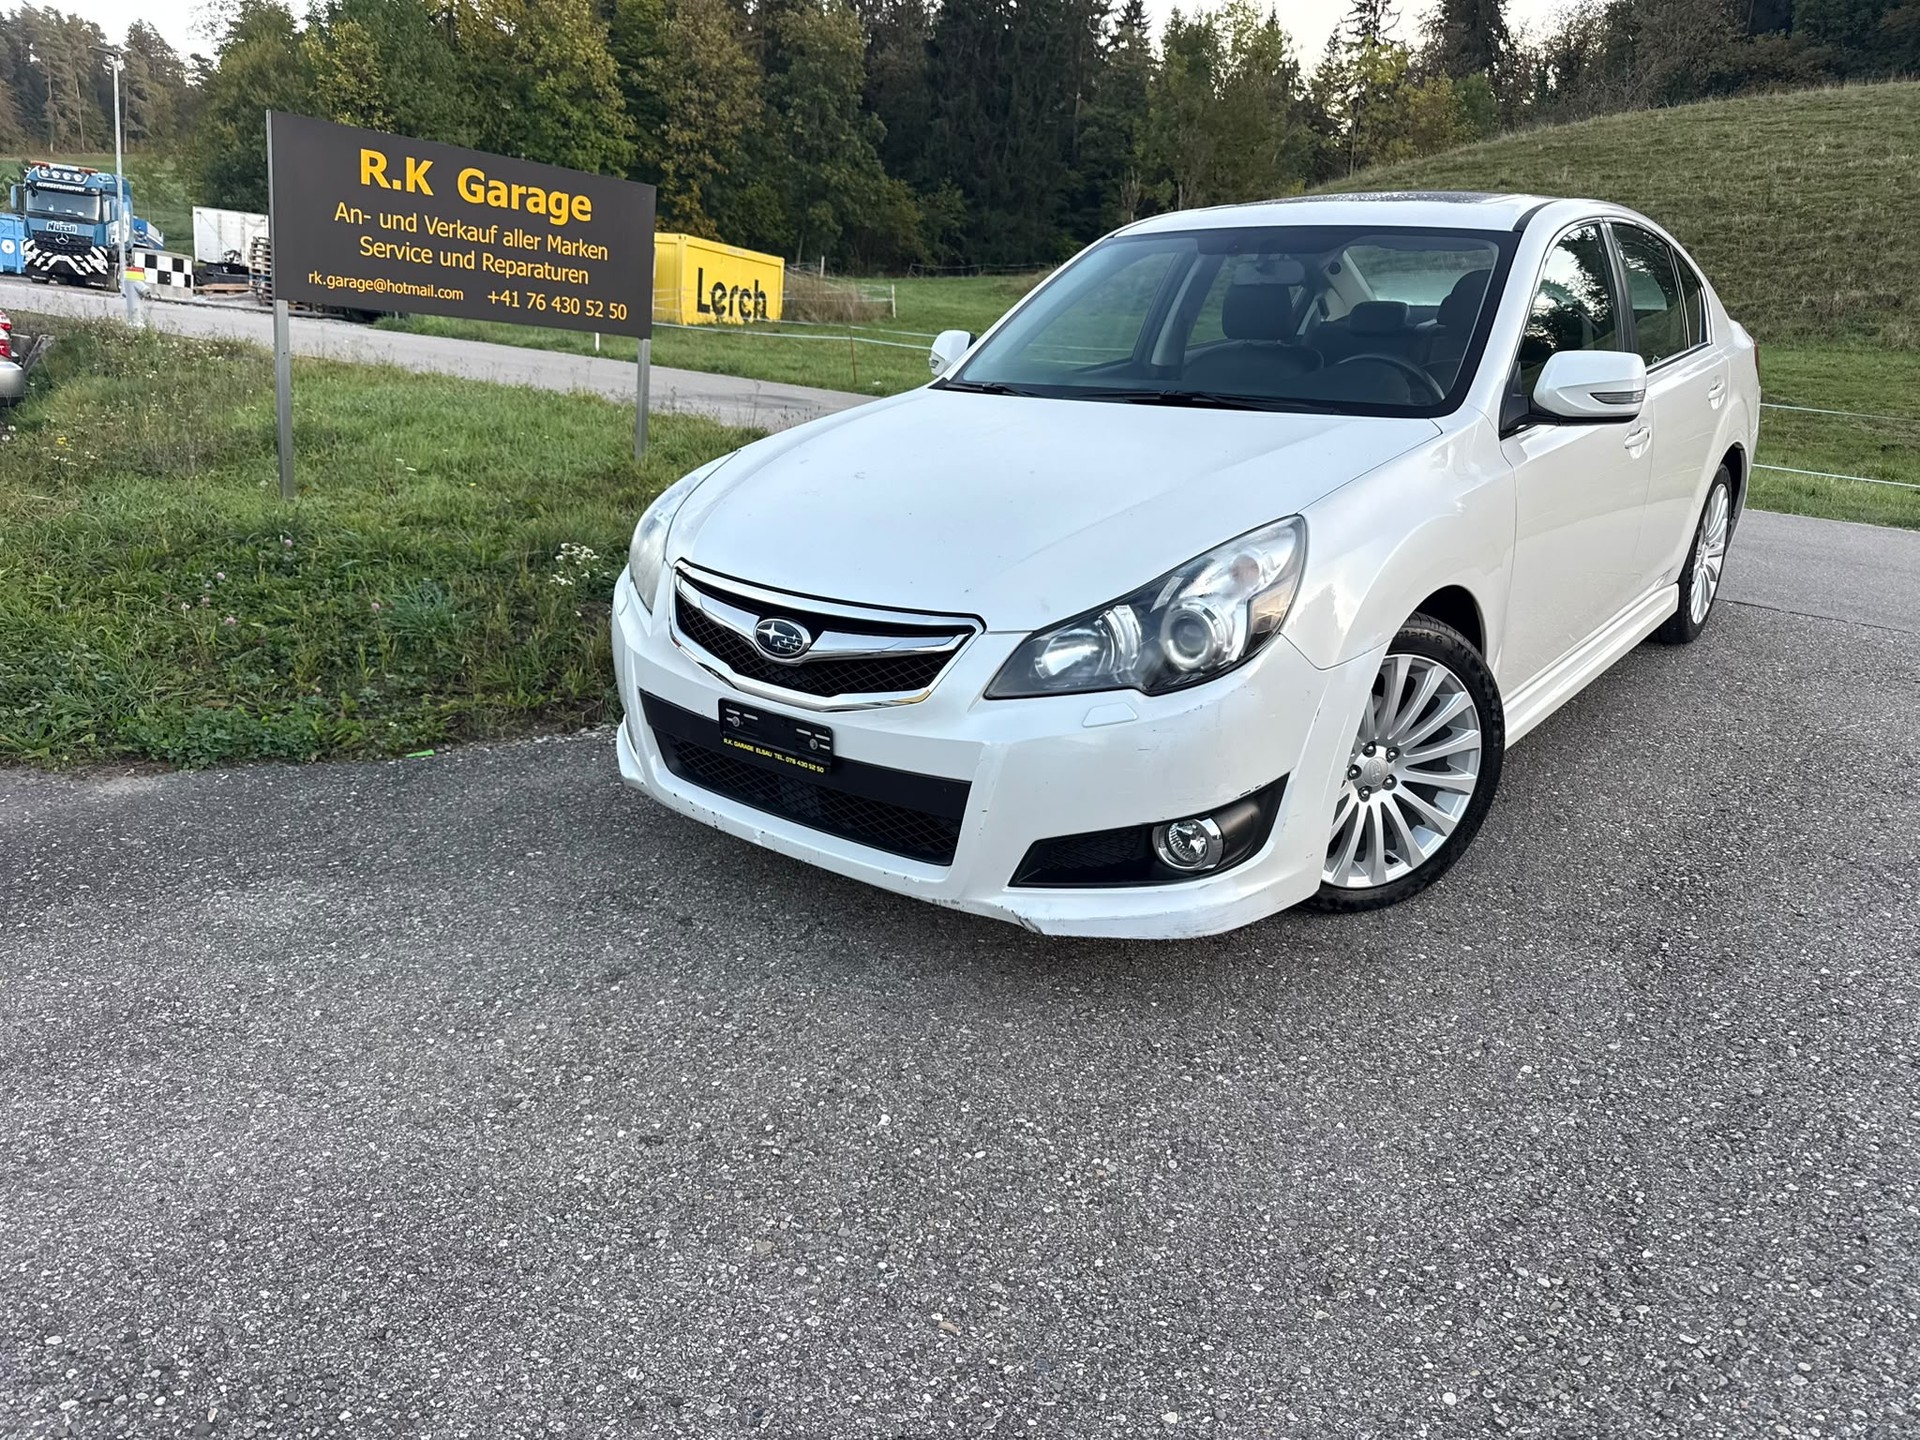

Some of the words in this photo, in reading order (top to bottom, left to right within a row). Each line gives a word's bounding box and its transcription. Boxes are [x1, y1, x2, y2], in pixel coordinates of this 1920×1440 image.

[360, 148, 434, 196] R.K
[457, 168, 593, 226] Garage
[334, 201, 372, 225] An-
[379, 211, 417, 233] und
[424, 215, 497, 245] Verkauf
[502, 227, 542, 250] aller
[547, 234, 608, 261] Marken
[359, 236, 433, 264] Service
[439, 247, 475, 270] und
[483, 253, 589, 285] Reparaturen
[308, 271, 464, 301] rk.garage@hotmail.com
[487, 290, 519, 308] +41
[526, 292, 546, 311] 76
[551, 295, 581, 315] 430
[585, 299, 604, 318] 52
[608, 302, 628, 321] 50
[697, 267, 767, 319] Lerch
[733, 740, 754, 752] GARAGE
